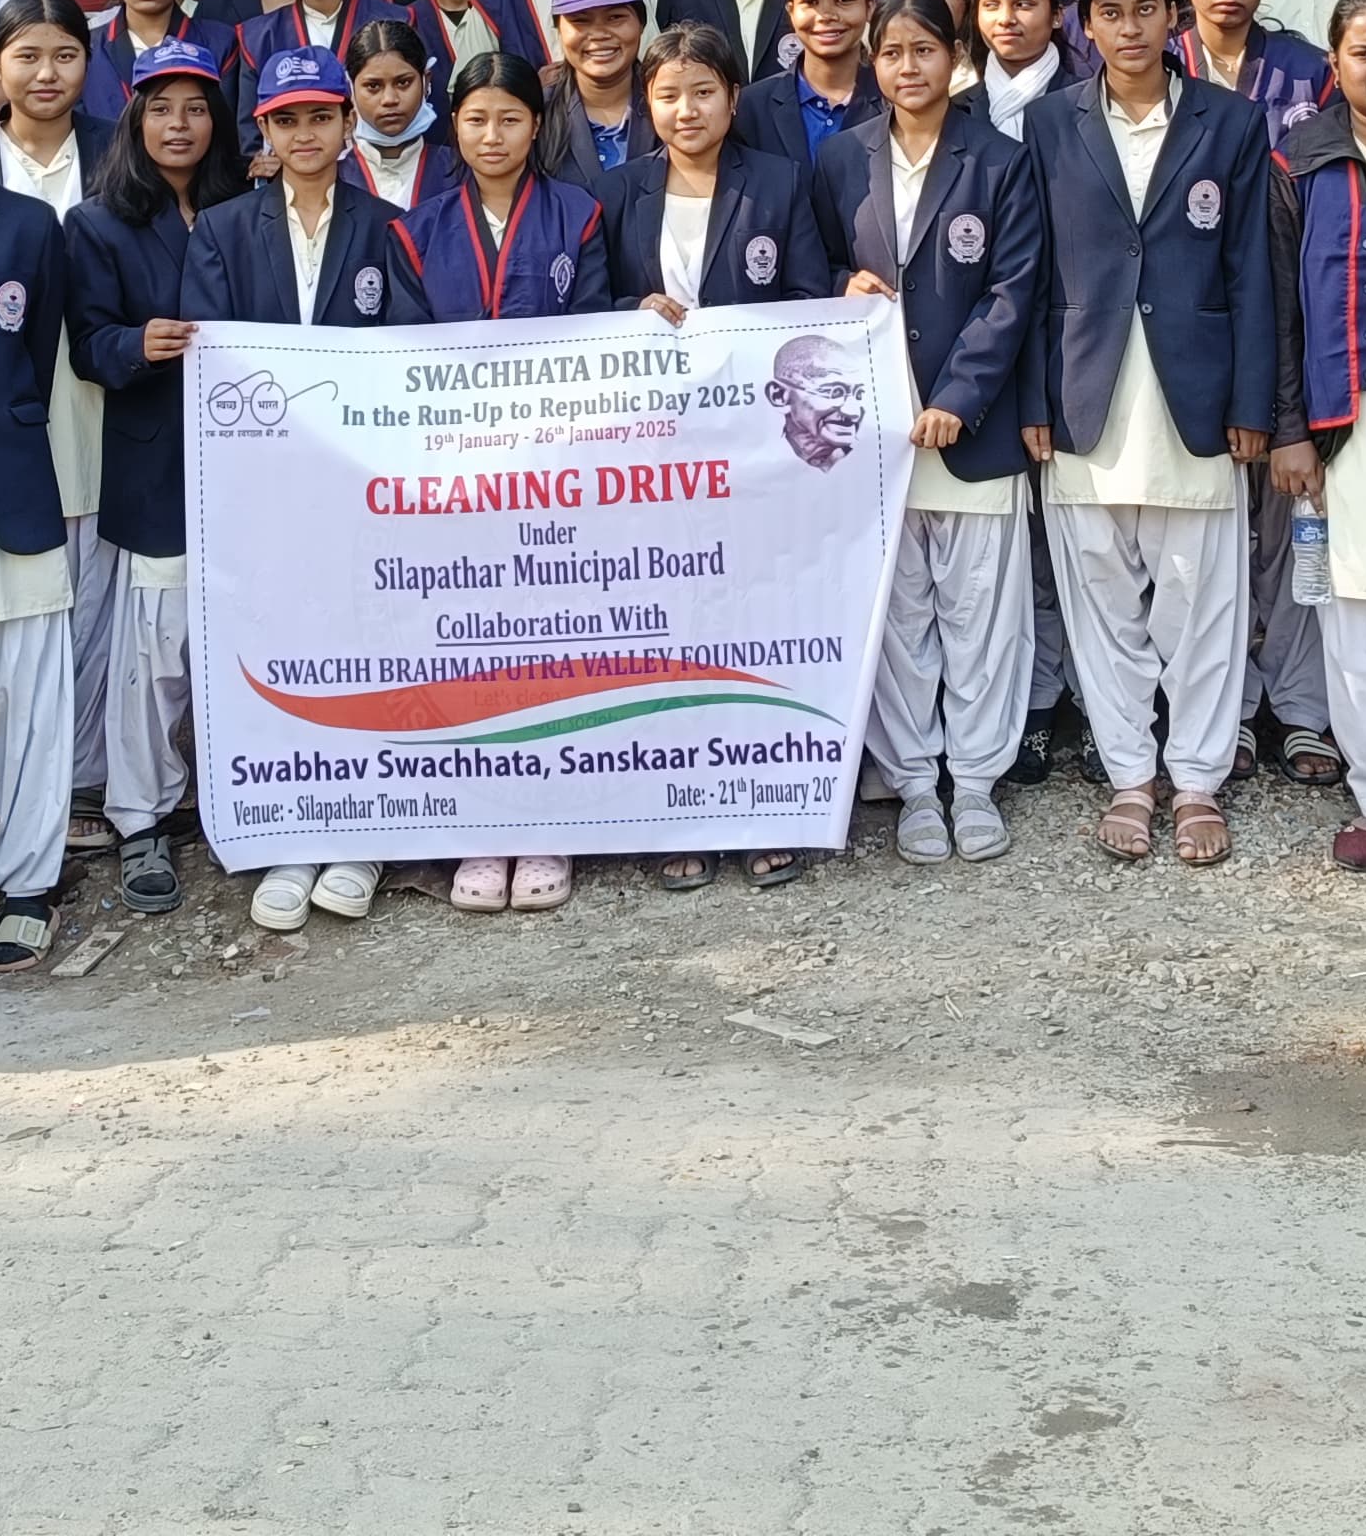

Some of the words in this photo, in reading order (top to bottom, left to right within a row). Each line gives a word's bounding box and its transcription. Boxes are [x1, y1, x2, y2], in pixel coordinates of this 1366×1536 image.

[405, 355, 591, 393] SWACHHATA
[600, 349, 692, 380] DRIVE
[341, 405, 367, 426] In
[372, 403, 410, 426] the
[418, 402, 503, 428] Run-Up
[511, 398, 532, 419] to
[539, 390, 642, 422] Republic
[647, 388, 692, 416] Day
[696, 382, 756, 409] 2025
[424, 432, 455, 451] 19th
[458, 427, 519, 454] January
[534, 425, 565, 445] 26th
[568, 423, 632, 446] January
[635, 419, 677, 439] 2025
[365, 468, 583, 516] CLEANING
[595, 459, 732, 507] DRIVE
[518, 520, 578, 547] Under
[373, 555, 507, 600] Silapathar
[512, 546, 641, 592] Municipal
[647, 541, 726, 580] Board
[435, 608, 603, 641] Collaboration
[608, 602, 669, 632] With
[266, 658, 373, 685] SWACHH
[378, 651, 576, 683] BRAHMAPUTRA
[580, 646, 675, 677] VALLEY
[680, 636, 844, 672] FOUNDATION
[231, 749, 370, 787] Swabhav
[377, 746, 551, 781] Swachhata,
[558, 740, 700, 776] Sanskaar
[707, 730, 849, 767] Swachha
[232, 799, 285, 827] Venue:
[296, 793, 375, 828] Silapathar
[377, 792, 419, 819] Town
[422, 791, 458, 817] Area
[666, 781, 707, 808] Date:
[718, 776, 748, 806] 21th
[750, 776, 810, 810] January
